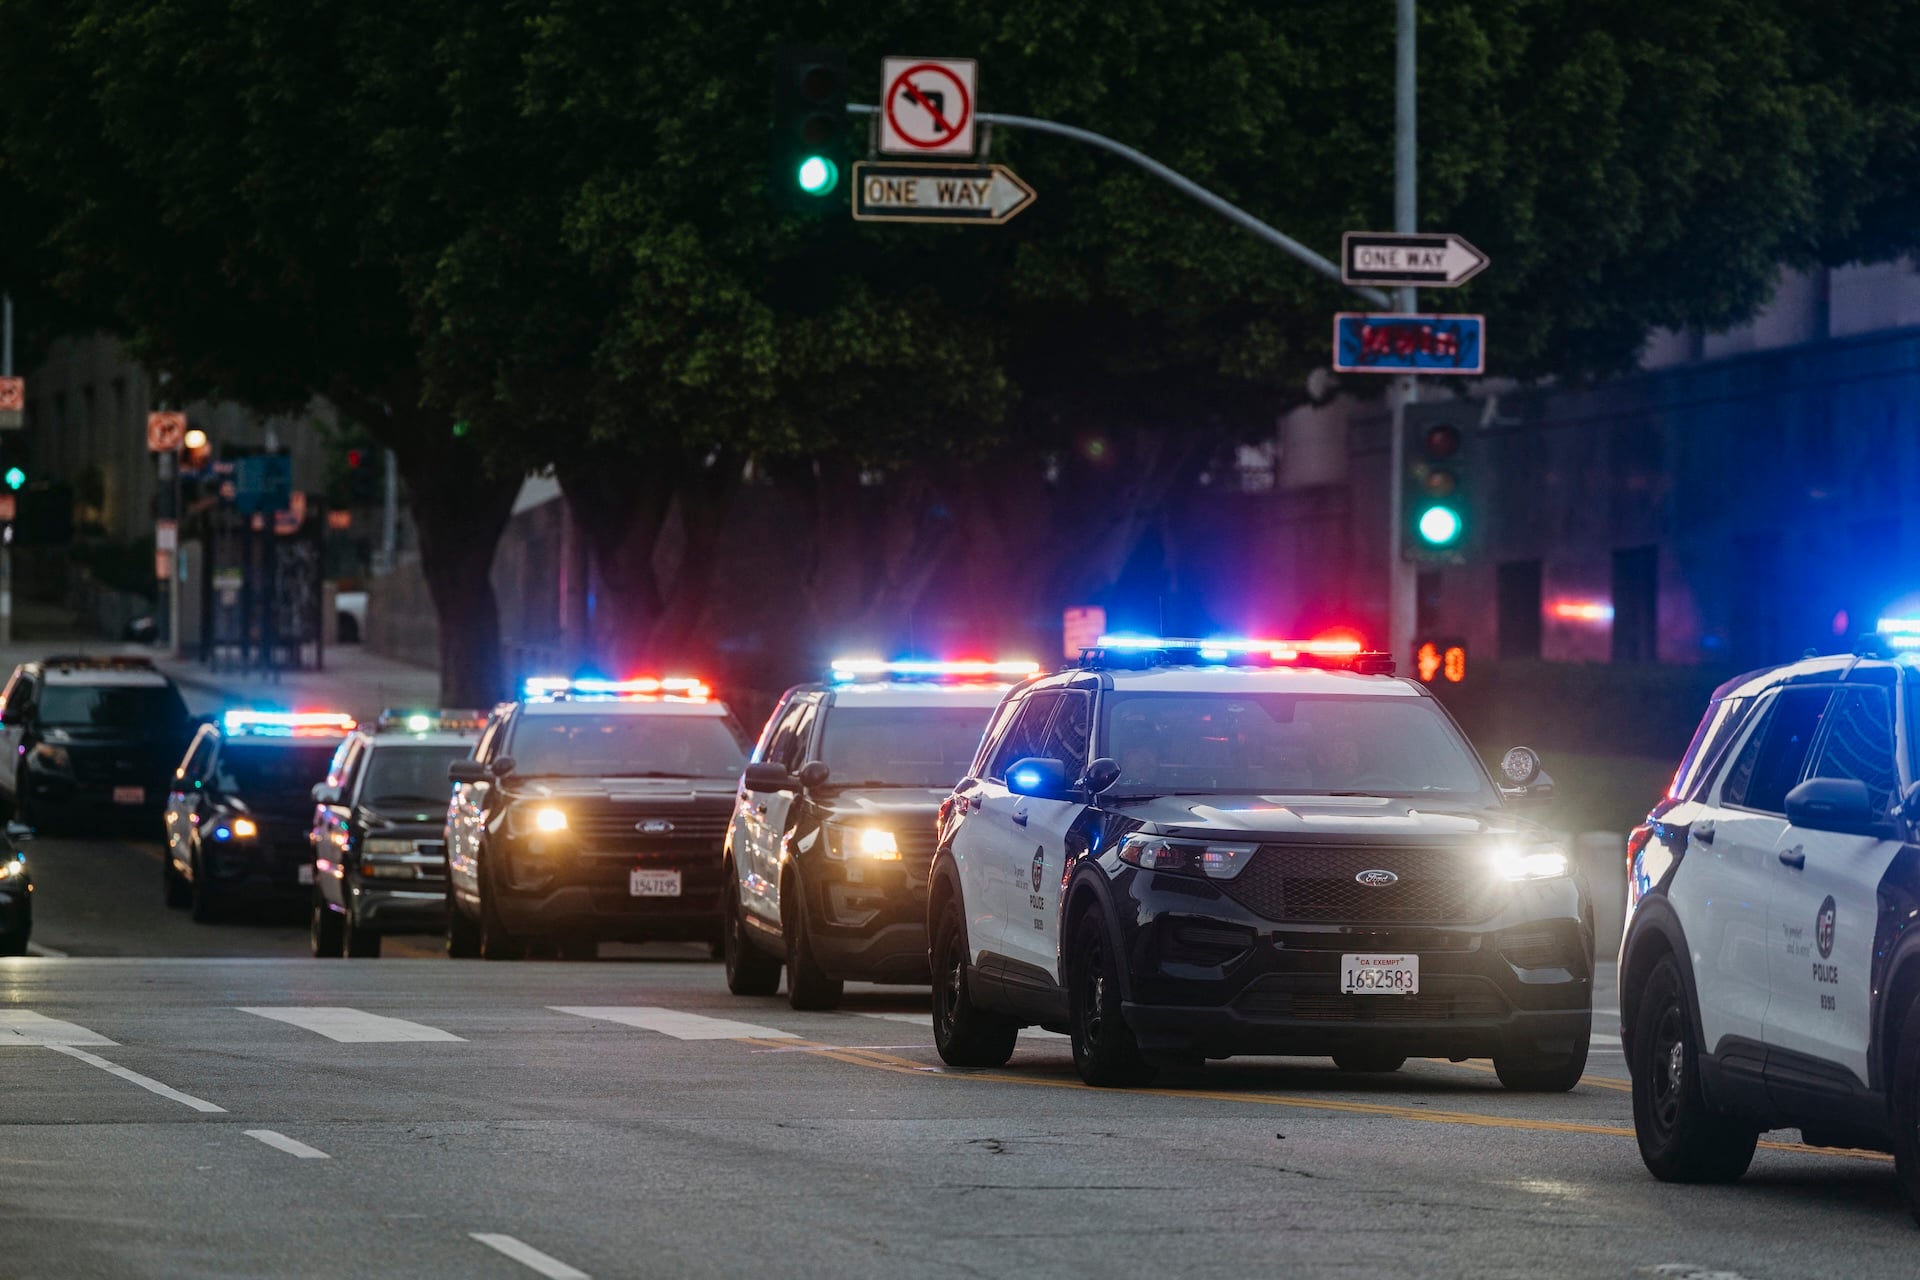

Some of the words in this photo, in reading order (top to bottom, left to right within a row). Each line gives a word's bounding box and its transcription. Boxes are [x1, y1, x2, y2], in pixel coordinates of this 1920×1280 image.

[868, 179, 918, 204] ONE
[936, 180, 990, 204] WAY
[1360, 251, 1397, 266] ONE
[1406, 252, 1443, 267] WAY
[1365, 872, 1389, 882] Ford
[1029, 894, 1044, 910] POLICE
[1346, 969, 1413, 989] 1652583
[1812, 963, 1838, 984] POLICE
